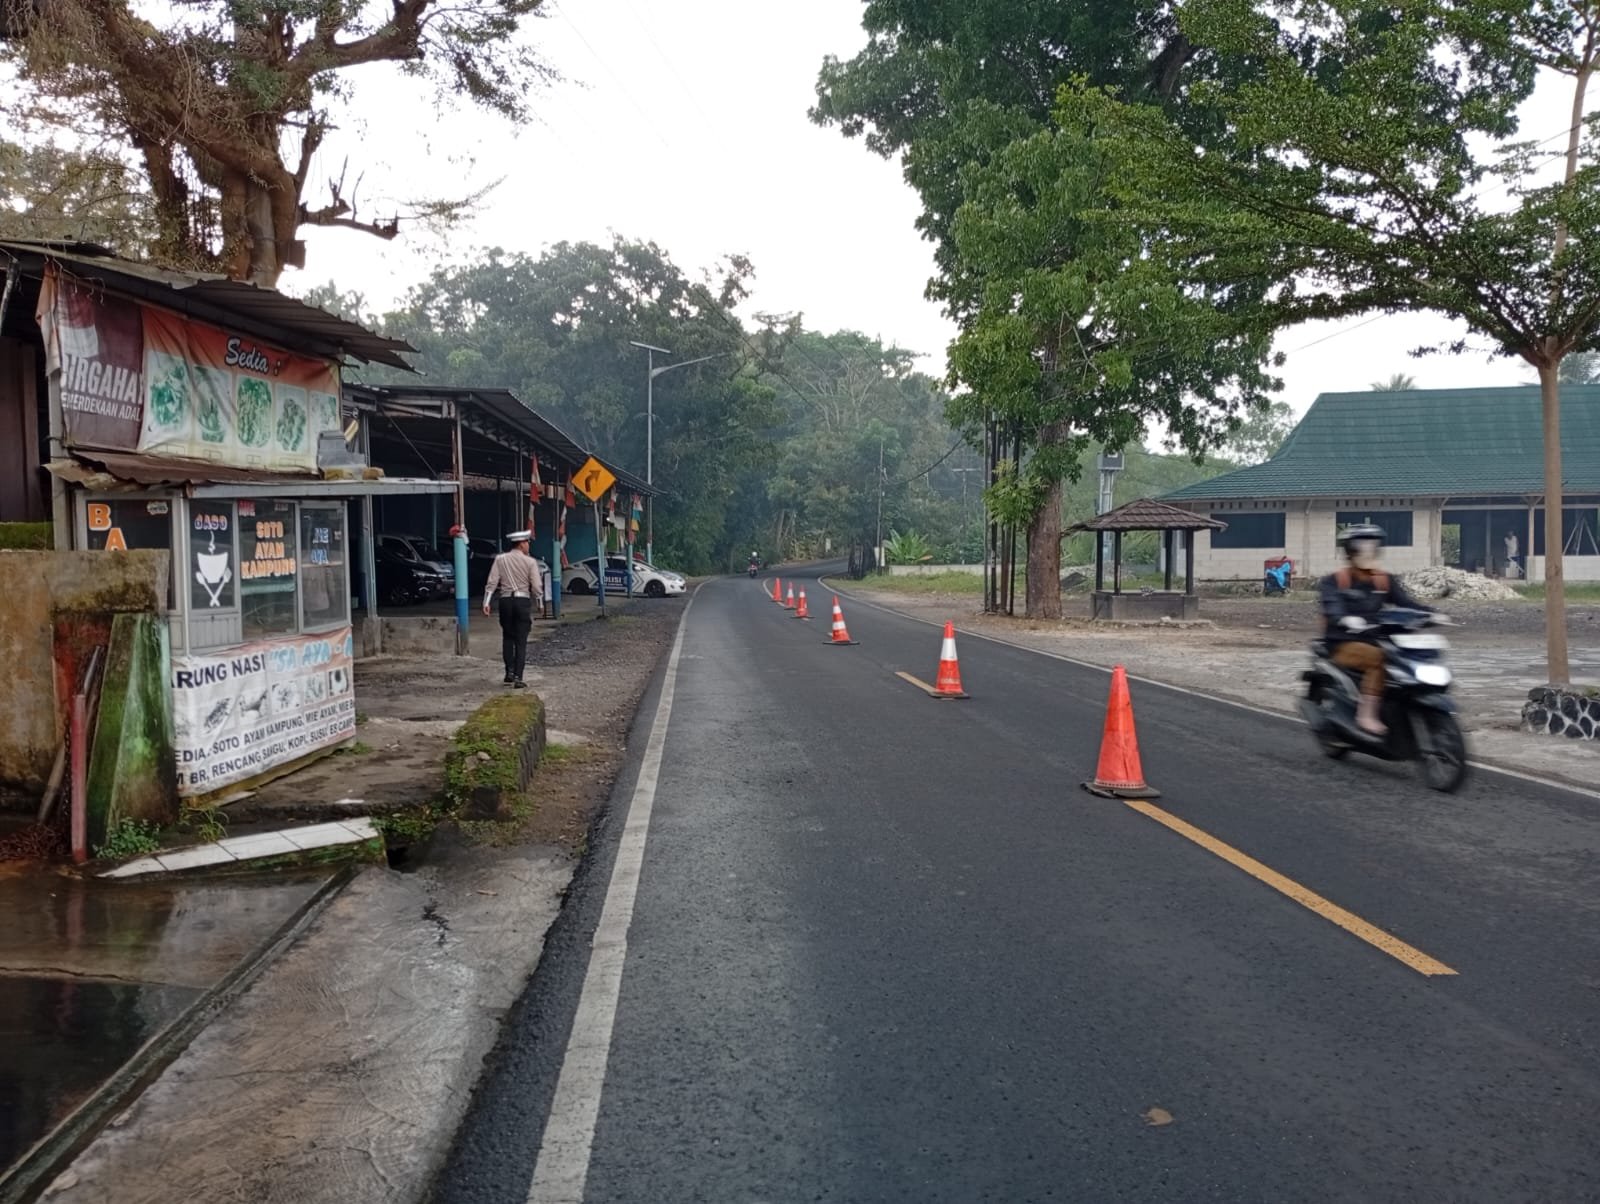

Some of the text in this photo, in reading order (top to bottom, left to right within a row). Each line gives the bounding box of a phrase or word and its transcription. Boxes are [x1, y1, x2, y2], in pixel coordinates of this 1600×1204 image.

[224, 337, 269, 374] Sedia
[256, 520, 284, 539] SOTO
[254, 541, 285, 560] AYAM
[241, 557, 296, 580] KAMPUNG
[170, 663, 227, 689] RUNG
[231, 653, 266, 677] NASI
[212, 736, 239, 756] SOTO
[243, 727, 265, 746] AYAM
[305, 710, 319, 723] MIE
[338, 700, 349, 712] MIE
[212, 751, 262, 778] RENCANG
